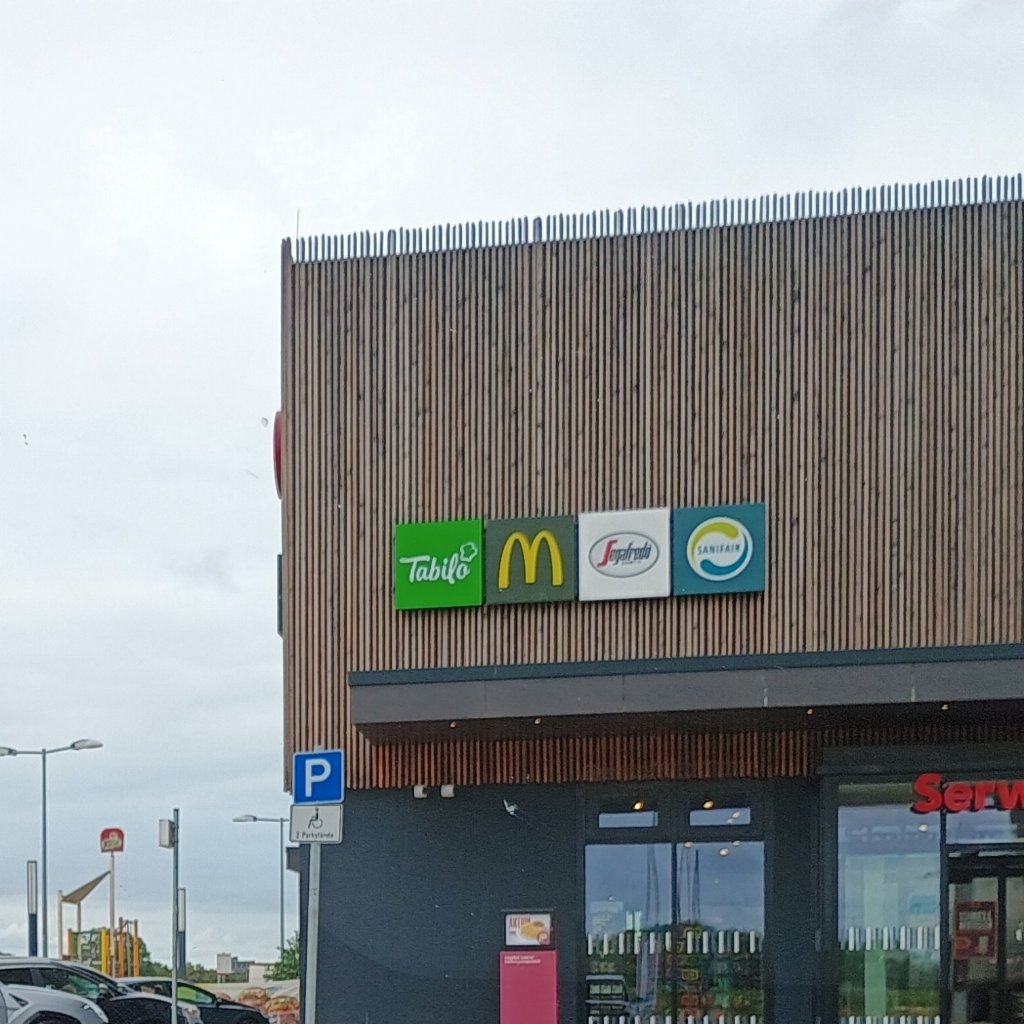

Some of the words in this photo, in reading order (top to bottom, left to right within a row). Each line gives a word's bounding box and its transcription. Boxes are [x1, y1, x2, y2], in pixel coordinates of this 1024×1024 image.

[597, 539, 652, 569] Segafredo
[697, 543, 741, 556] SANIFAIR
[305, 759, 331, 797] P
